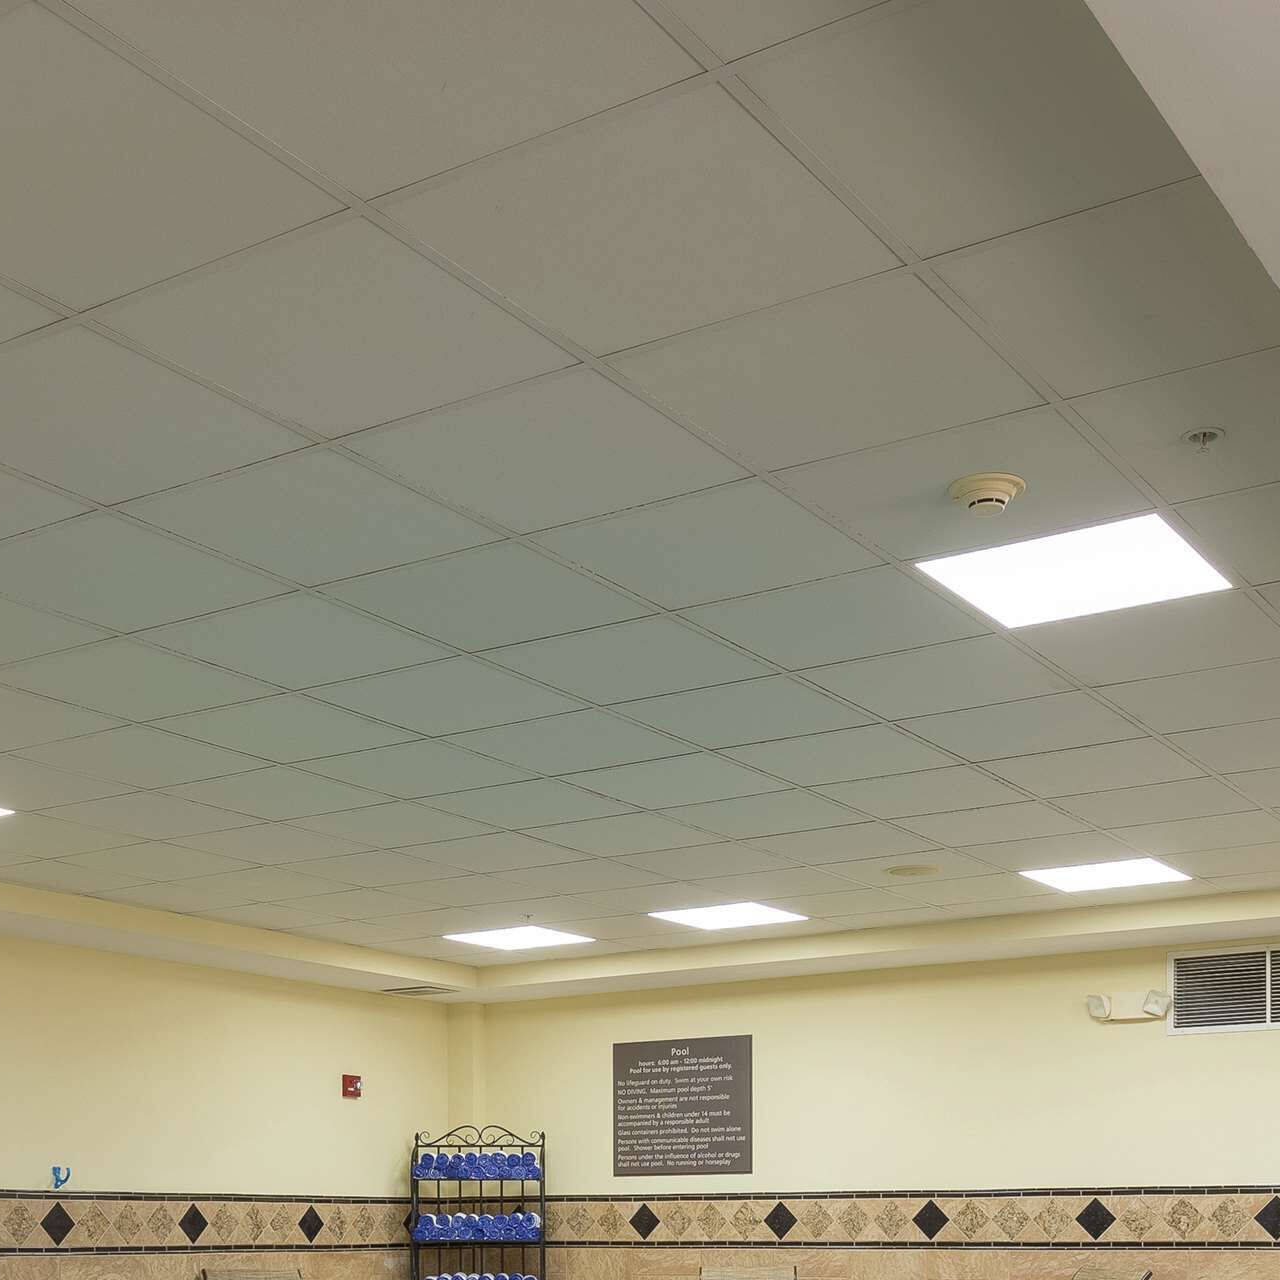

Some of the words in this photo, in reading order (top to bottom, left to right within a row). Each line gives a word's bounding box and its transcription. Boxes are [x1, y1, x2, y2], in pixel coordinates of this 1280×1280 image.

[671, 1047, 689, 1056] Pool
[671, 1064, 698, 1072] registered
[677, 1085, 689, 1094] pool
[700, 1093, 730, 1102] responsible
